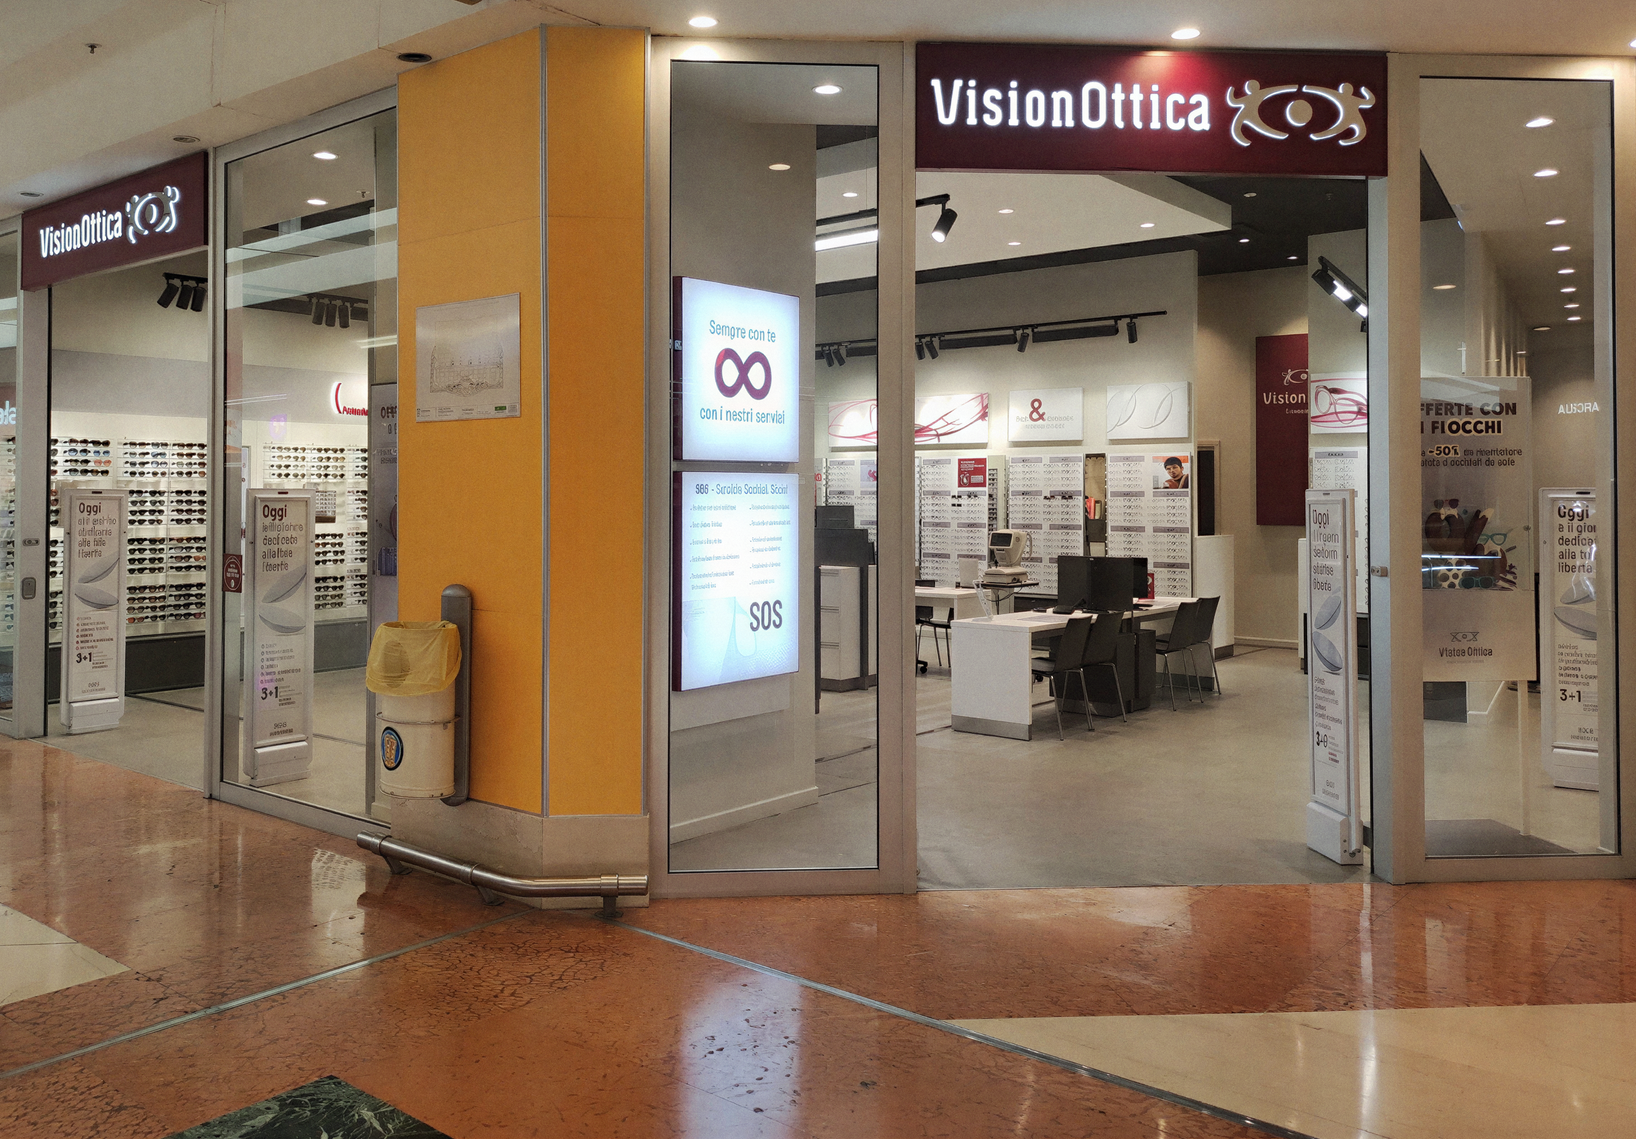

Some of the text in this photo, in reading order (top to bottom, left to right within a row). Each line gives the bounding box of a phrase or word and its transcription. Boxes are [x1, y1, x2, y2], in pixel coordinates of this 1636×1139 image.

[930, 78, 1211, 131] VisionOttica
[39, 209, 123, 259] VisionOttica
[748, 328, 765, 341] con
[767, 328, 776, 343] te
[699, 407, 718, 421] con
[1480, 402, 1517, 416] CON
[1431, 420, 1503, 435] FIOCCHI
[78, 502, 102, 516] Oggi
[262, 504, 288, 522] Oggi
[749, 599, 783, 632] SOS
[260, 686, 279, 701] 3+1
[1559, 688, 1582, 703] 3+1
